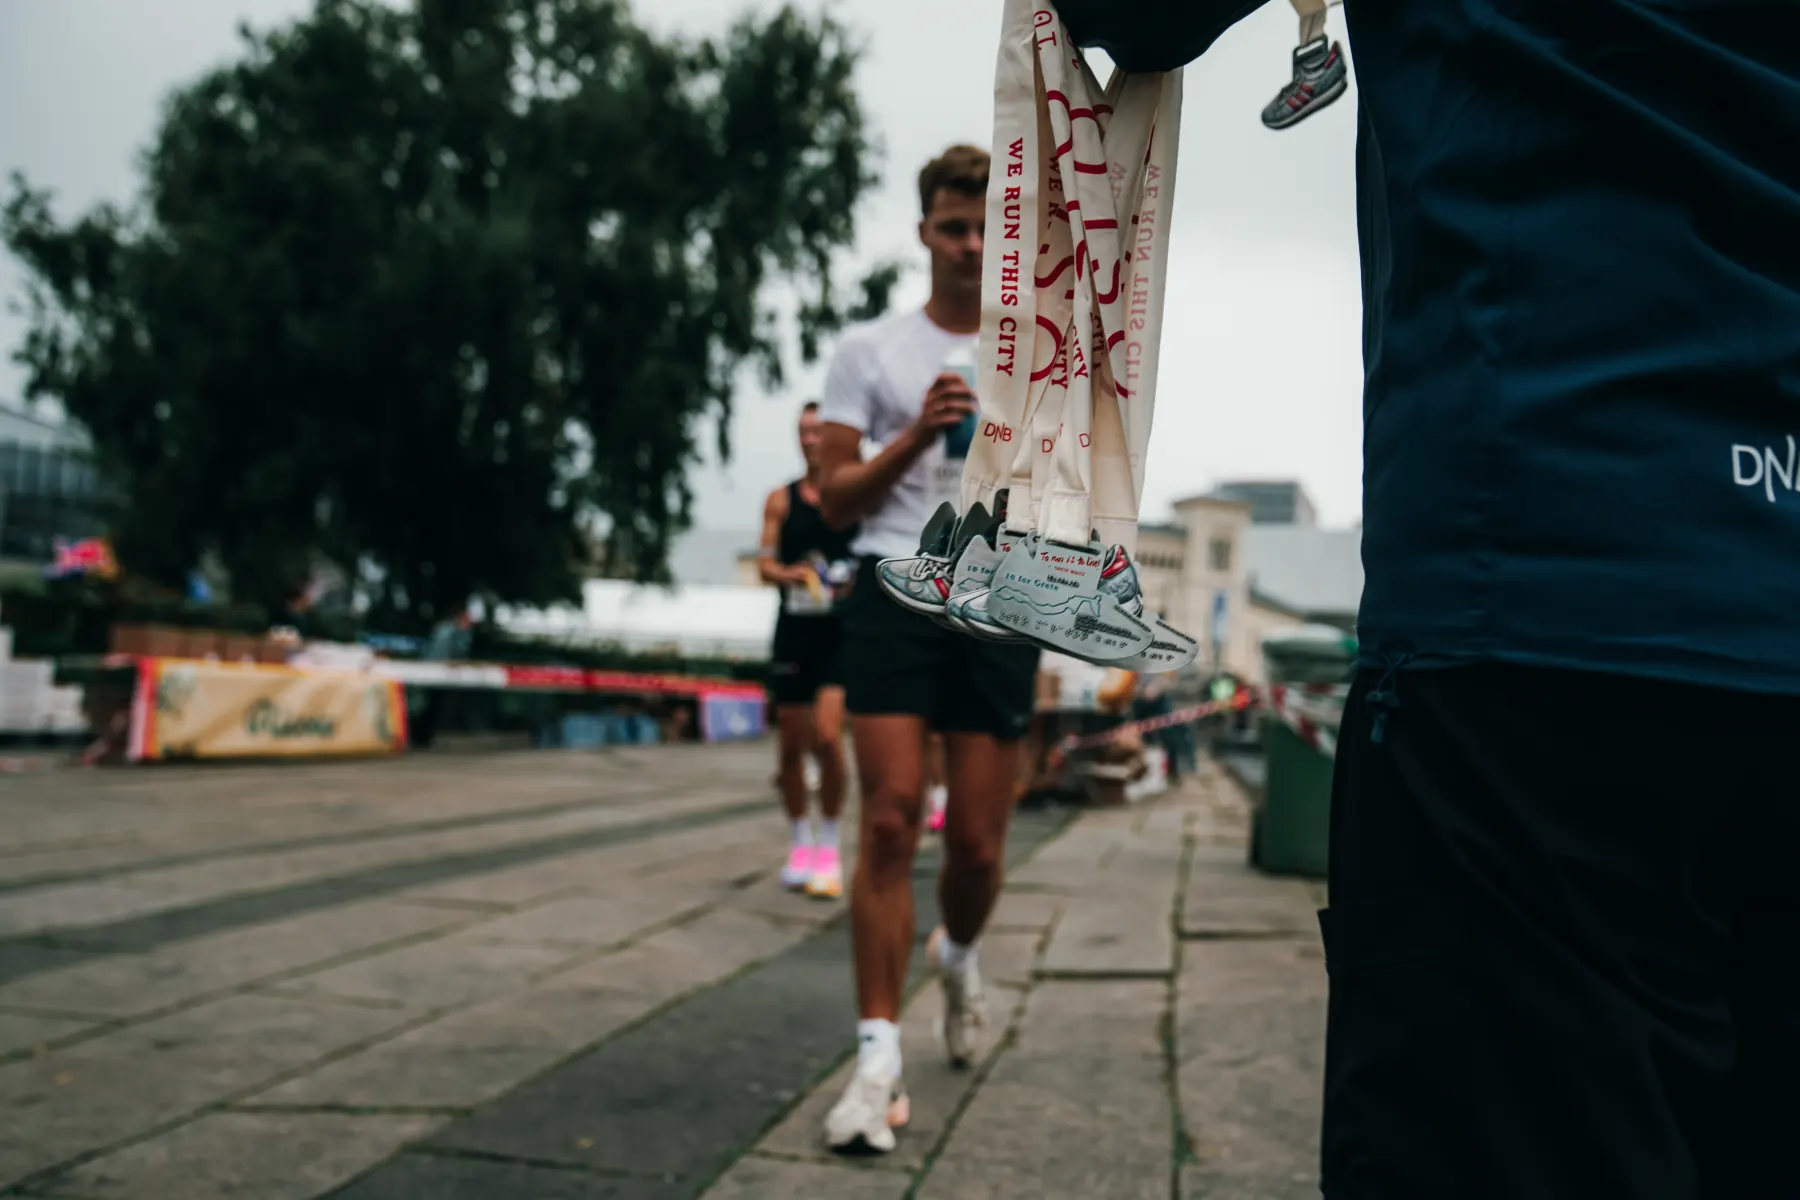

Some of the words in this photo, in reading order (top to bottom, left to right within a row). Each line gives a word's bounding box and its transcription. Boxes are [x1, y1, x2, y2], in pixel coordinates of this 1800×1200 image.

[1008, 137, 1024, 178] WE
[1004, 185, 1021, 241] RUN
[1001, 250, 1019, 307] THIS
[996, 316, 1017, 377] CITY
[1051, 335, 1068, 390] ITY
[984, 421, 1013, 443] DNB
[1731, 434, 1800, 503] DN
[1040, 551, 1050, 563] To
